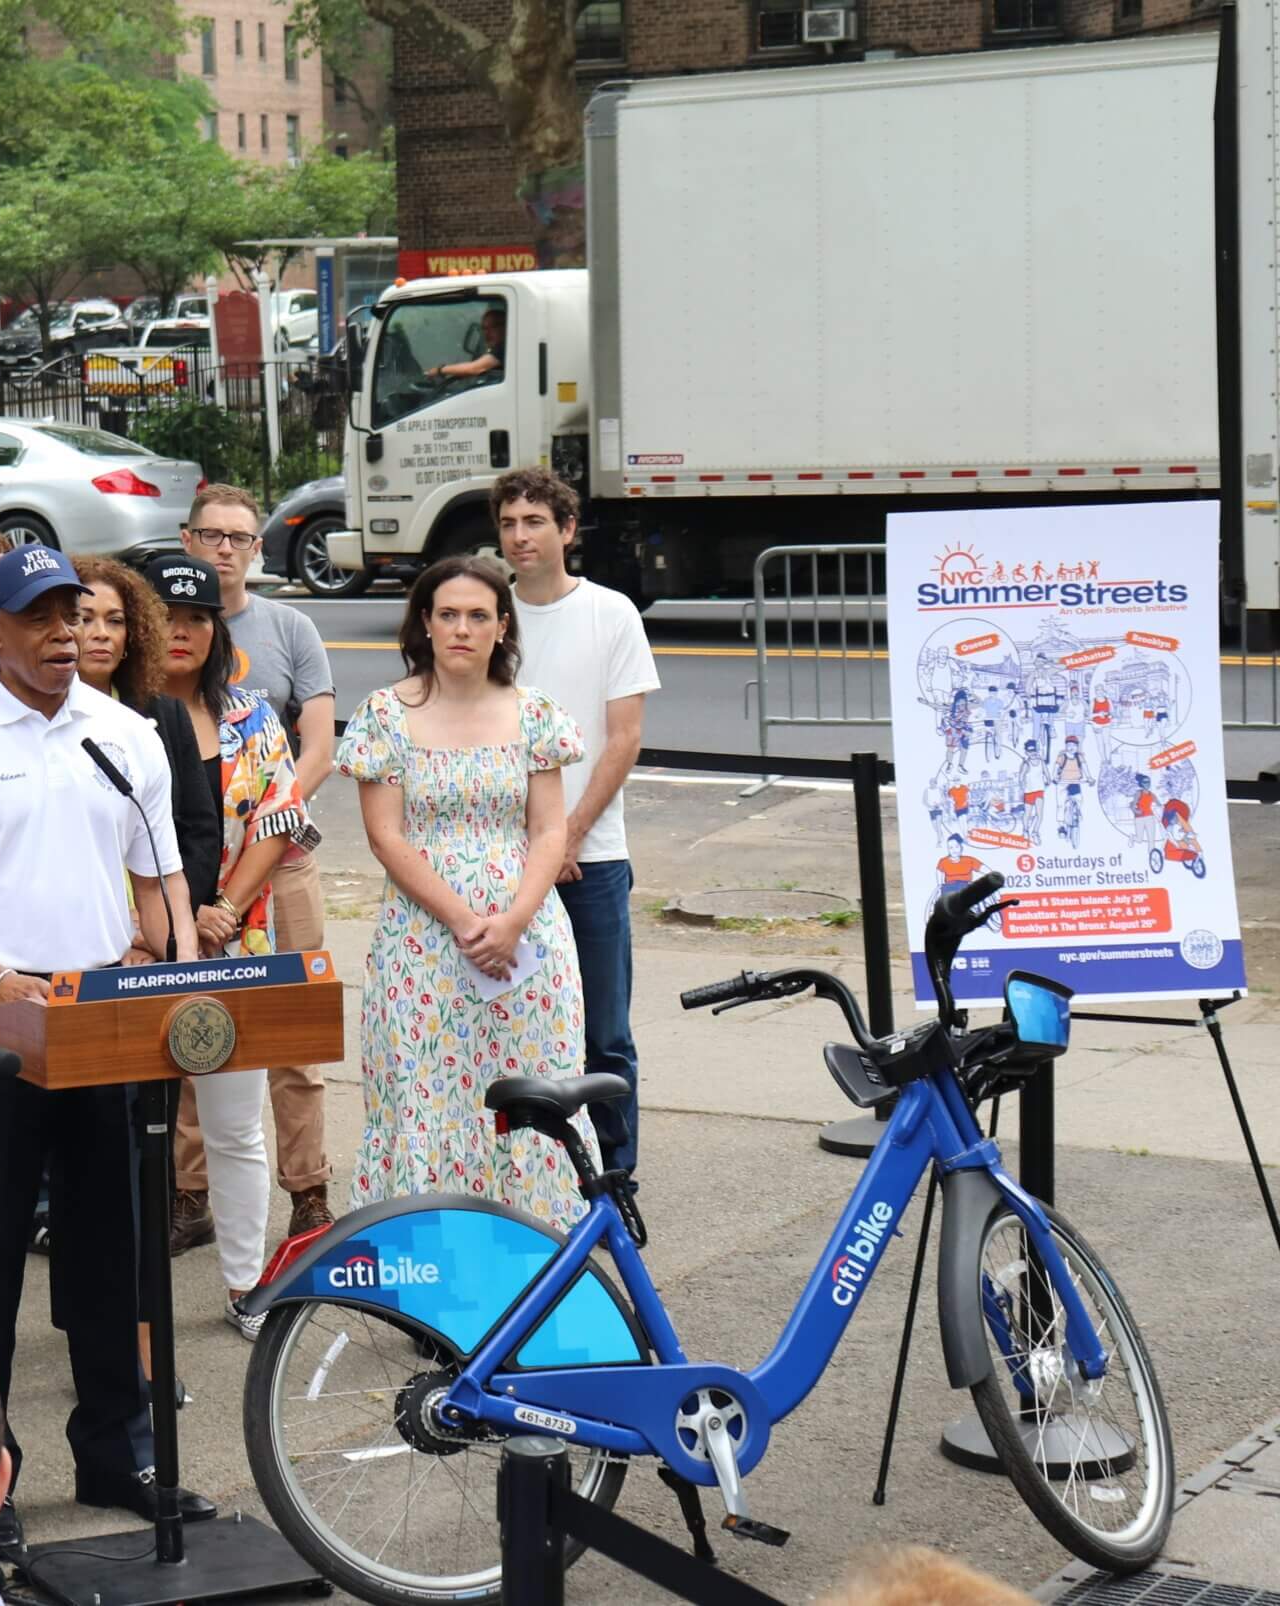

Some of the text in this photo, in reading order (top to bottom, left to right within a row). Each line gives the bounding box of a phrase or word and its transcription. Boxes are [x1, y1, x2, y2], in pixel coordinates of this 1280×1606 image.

[427, 253, 535, 272] VERNON BLVD
[433, 417, 487, 430] TRANSPORTATION
[449, 441, 472, 452] STREET
[400, 458, 416, 468] LONG
[417, 456, 439, 467] ISLAND
[24, 549, 49, 561] NYC
[22, 558, 60, 576] MAYOR
[162, 567, 207, 582] BROOKLYN
[940, 571, 983, 585] NYC
[1075, 607, 1102, 616] Open
[1105, 605, 1143, 614] Streets
[1145, 603, 1188, 612] Initiative
[1132, 634, 1172, 649] Brooklyn
[1065, 649, 1112, 667] Manhattan
[1022, 853, 1122, 870] 5 Saturdays of
[1035, 873, 1091, 887] Summer
[1096, 870, 1149, 884] Streets!
[1060, 909, 1091, 920] August
[1009, 923, 1048, 934] Brooklyn
[1060, 922, 1077, 931] The
[1109, 919, 1140, 930] August
[1059, 947, 1174, 963] nyc.gov/summerstreets
[118, 965, 268, 991] HEARFROMERIC.COM
[832, 1201, 893, 1306] citi bike
[329, 1257, 440, 1287] citi bike
[519, 1410, 572, 1432] 461-8732
